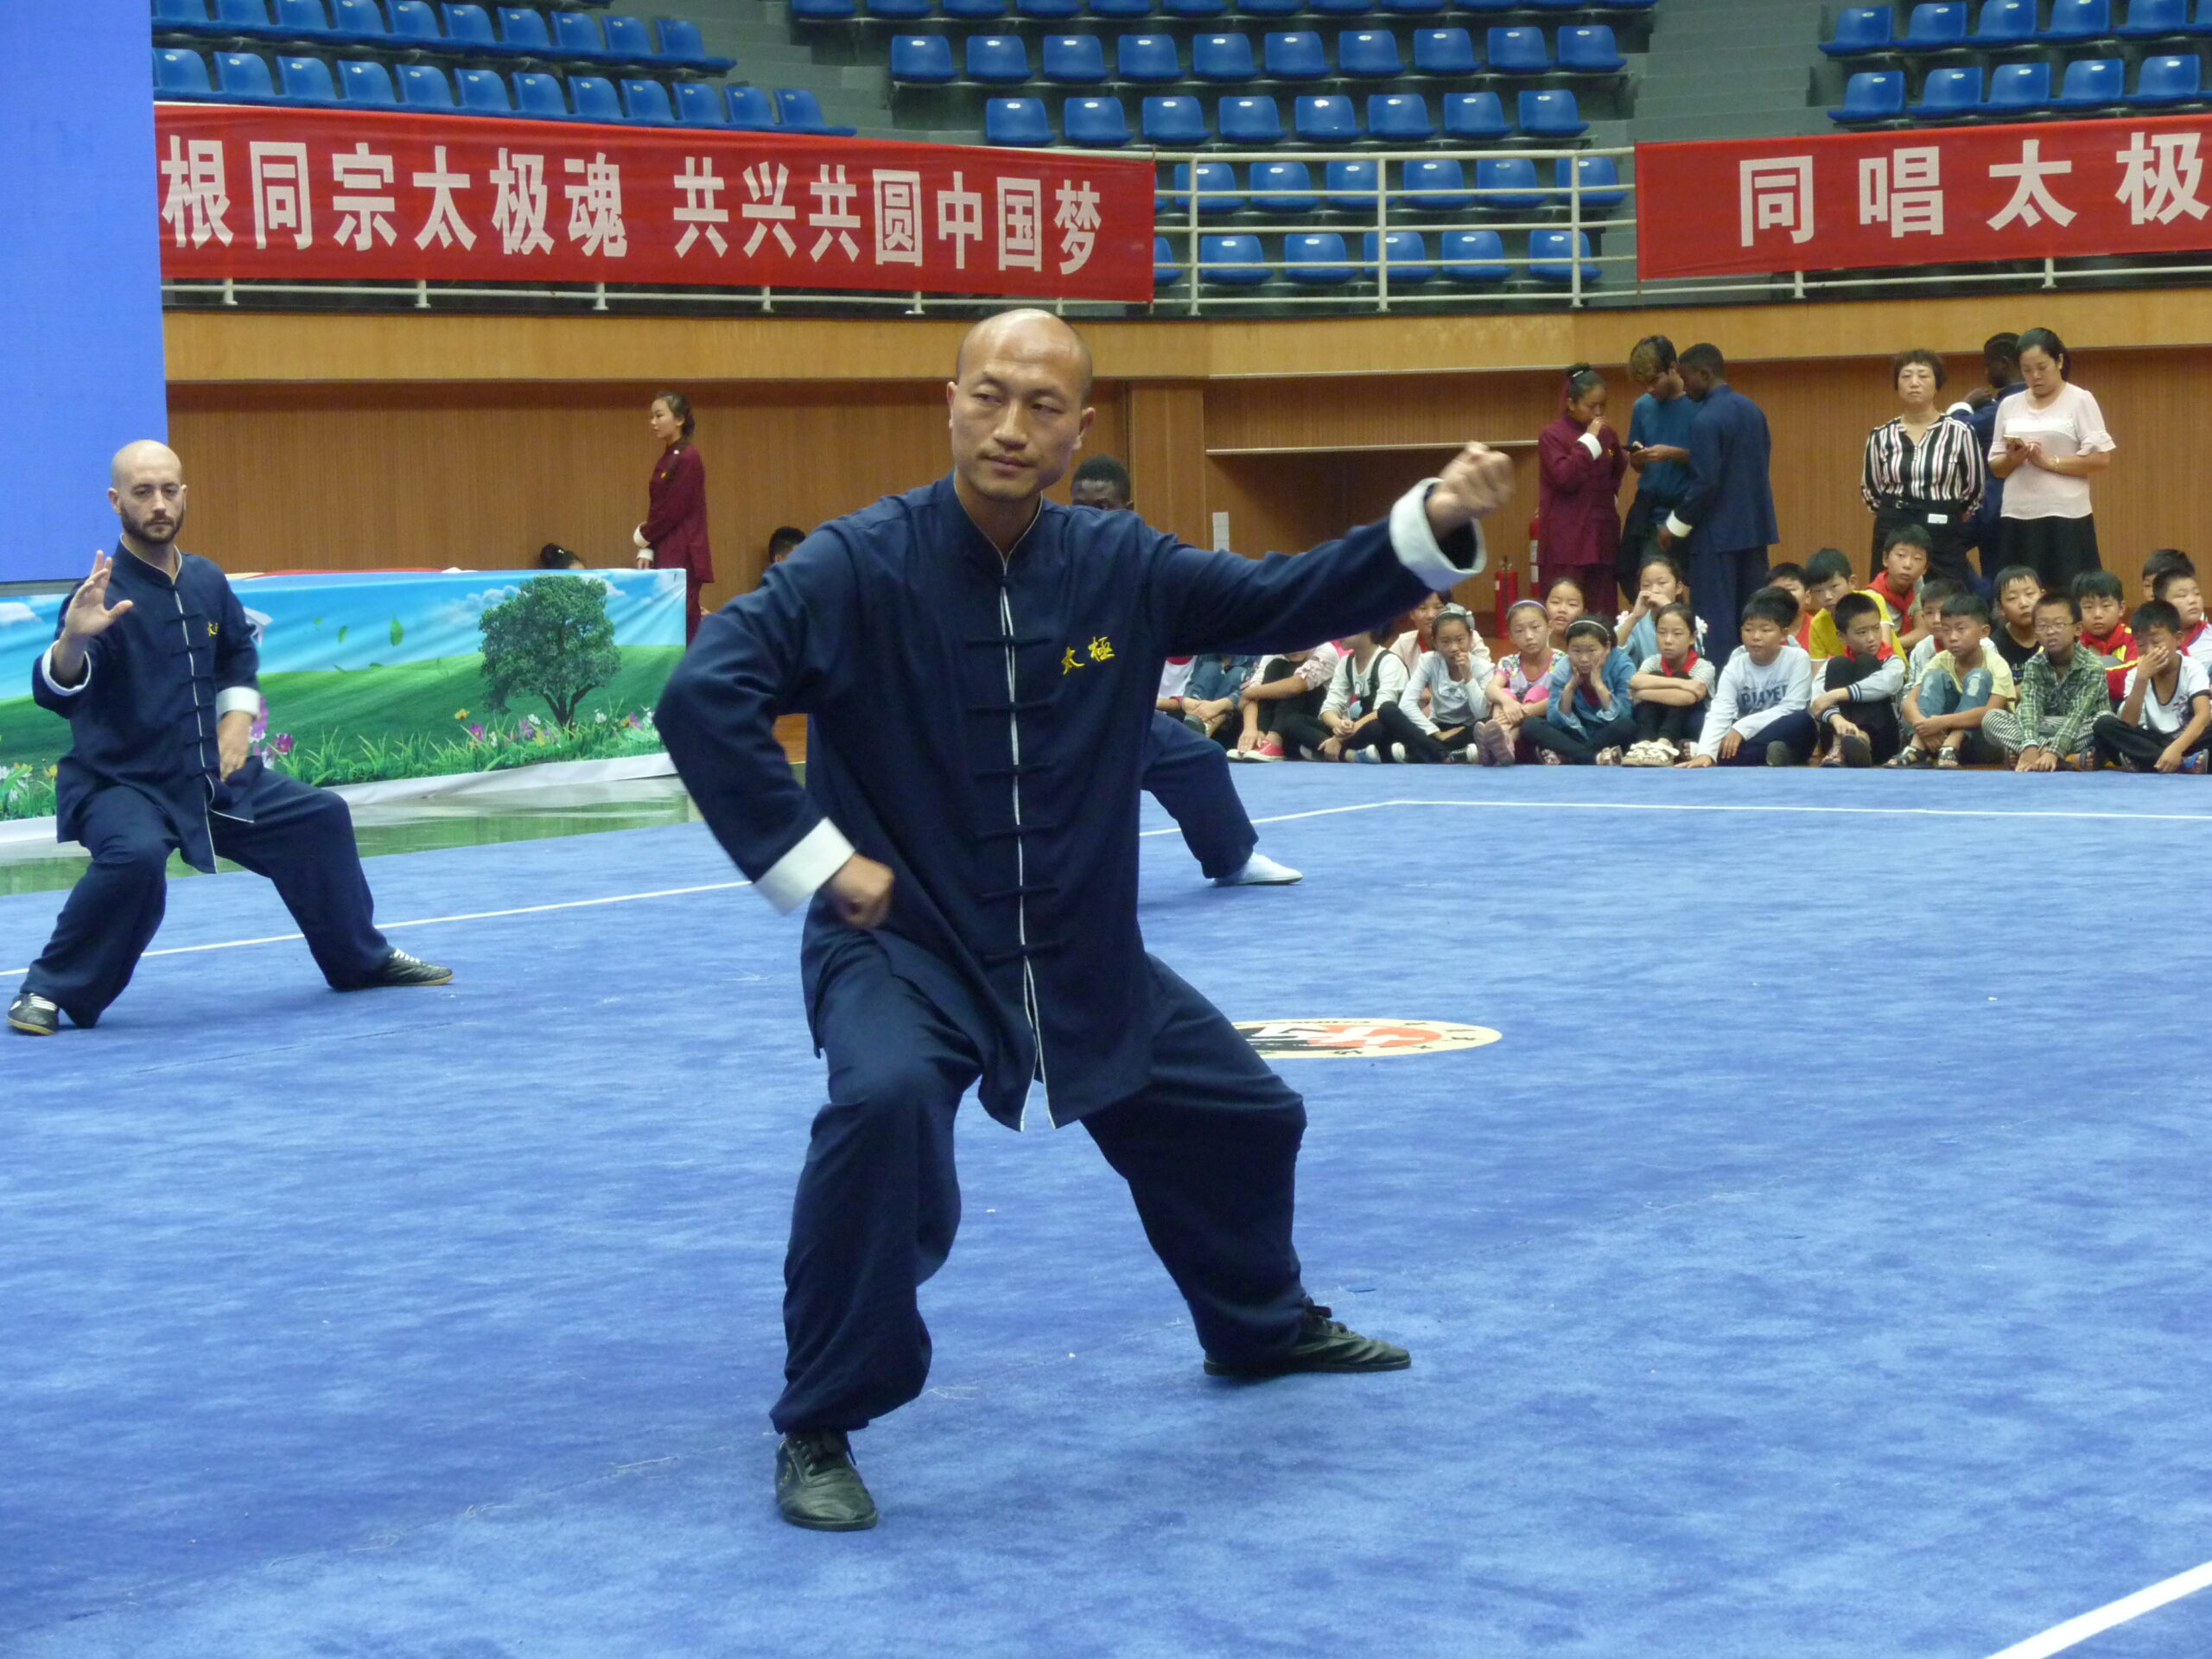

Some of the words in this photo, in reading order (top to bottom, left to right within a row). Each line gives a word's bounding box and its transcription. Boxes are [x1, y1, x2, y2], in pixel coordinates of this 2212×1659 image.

[162, 135, 627, 257] 根同宗太极魂
[673, 156, 1102, 275] 共兴共圆中国梦
[1739, 131, 2210, 247] 同唱太极
